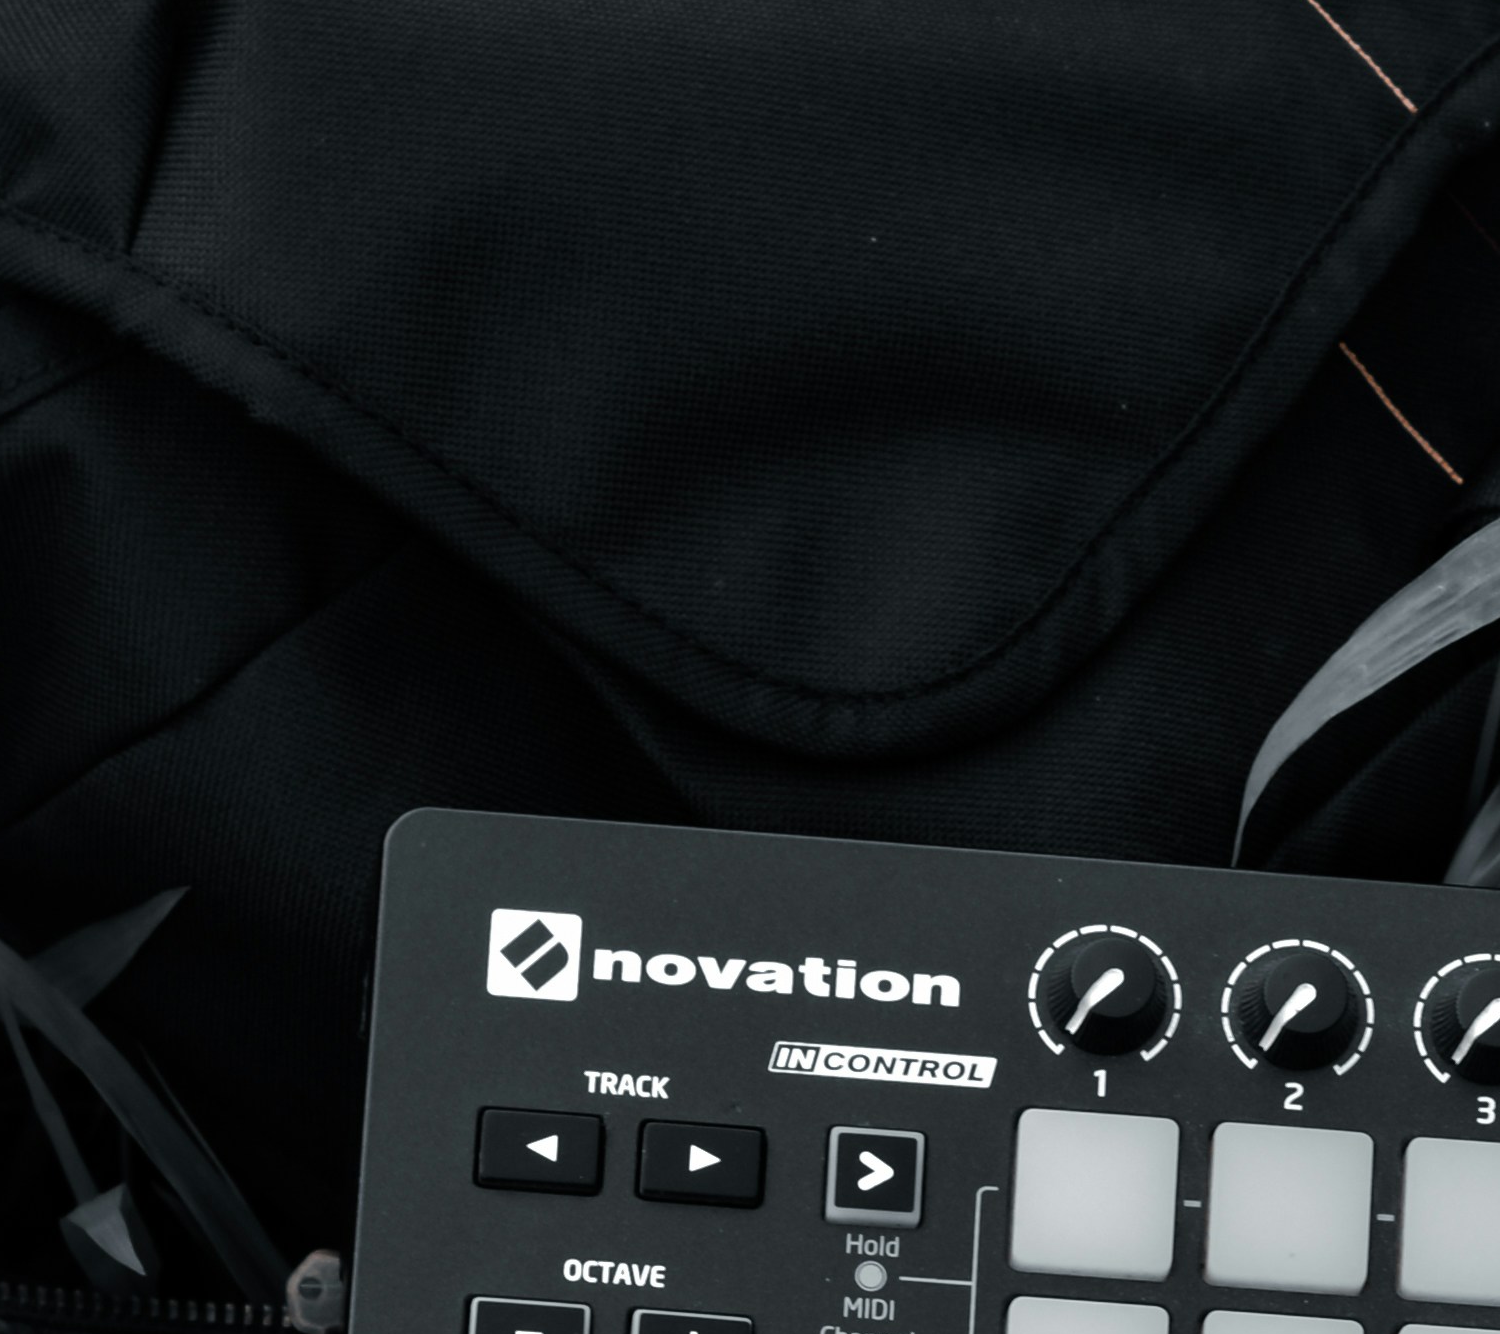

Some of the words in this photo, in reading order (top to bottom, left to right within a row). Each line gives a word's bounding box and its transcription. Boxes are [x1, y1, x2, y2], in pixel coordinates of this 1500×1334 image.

[592, 948, 962, 1008] novation
[823, 1051, 984, 1082] CONTROL
[583, 1070, 671, 1100] TRACK
[1093, 1069, 1107, 1098] 1
[1283, 1082, 1305, 1111] 2
[1476, 1096, 1497, 1125] 3
[845, 1233, 900, 1258] Hold
[563, 1258, 667, 1289] OCTAVE
[843, 1296, 895, 1322] MIDI
